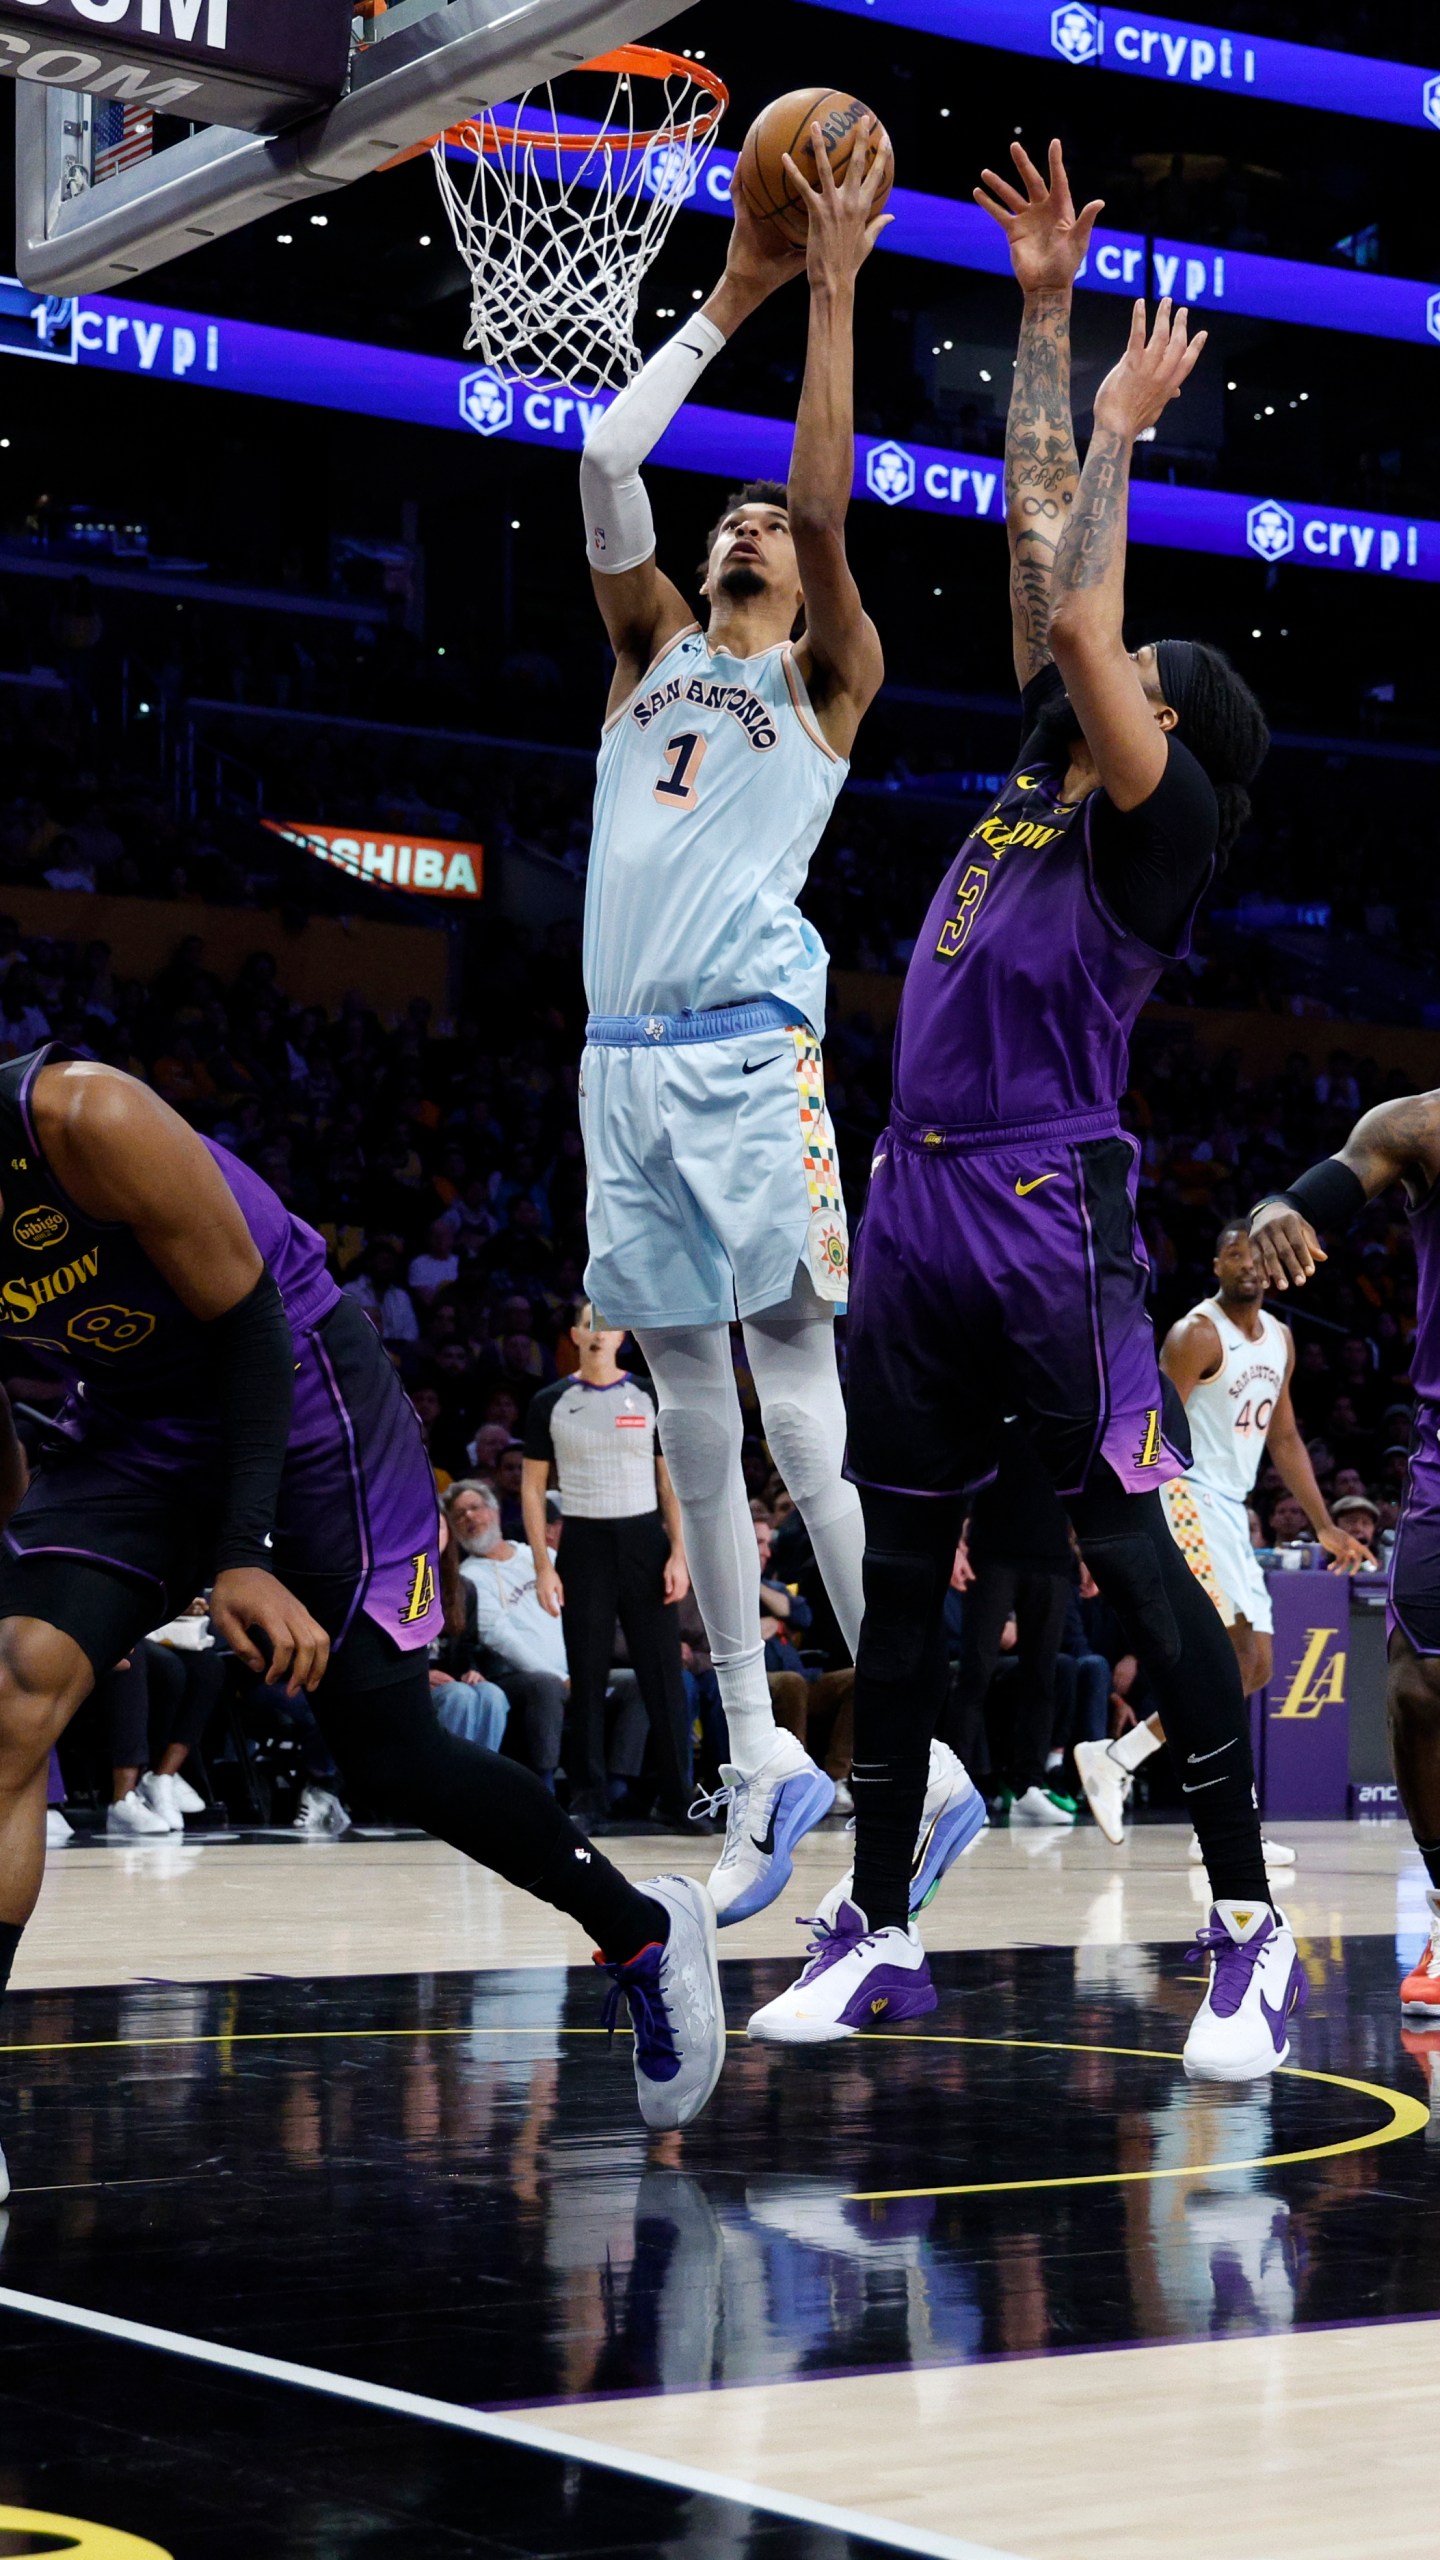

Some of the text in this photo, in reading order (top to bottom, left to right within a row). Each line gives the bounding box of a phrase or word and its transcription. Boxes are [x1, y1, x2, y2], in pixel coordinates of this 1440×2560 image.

[632, 676, 778, 751] SAN ANTONIO
[654, 731, 704, 807] 1
[935, 864, 989, 958] 3
[11, 1158, 28, 1170] 44
[17, 1213, 64, 1241] bibigo
[1235, 1398, 1273, 1433] 40
[1270, 1627, 1347, 1719] LA
